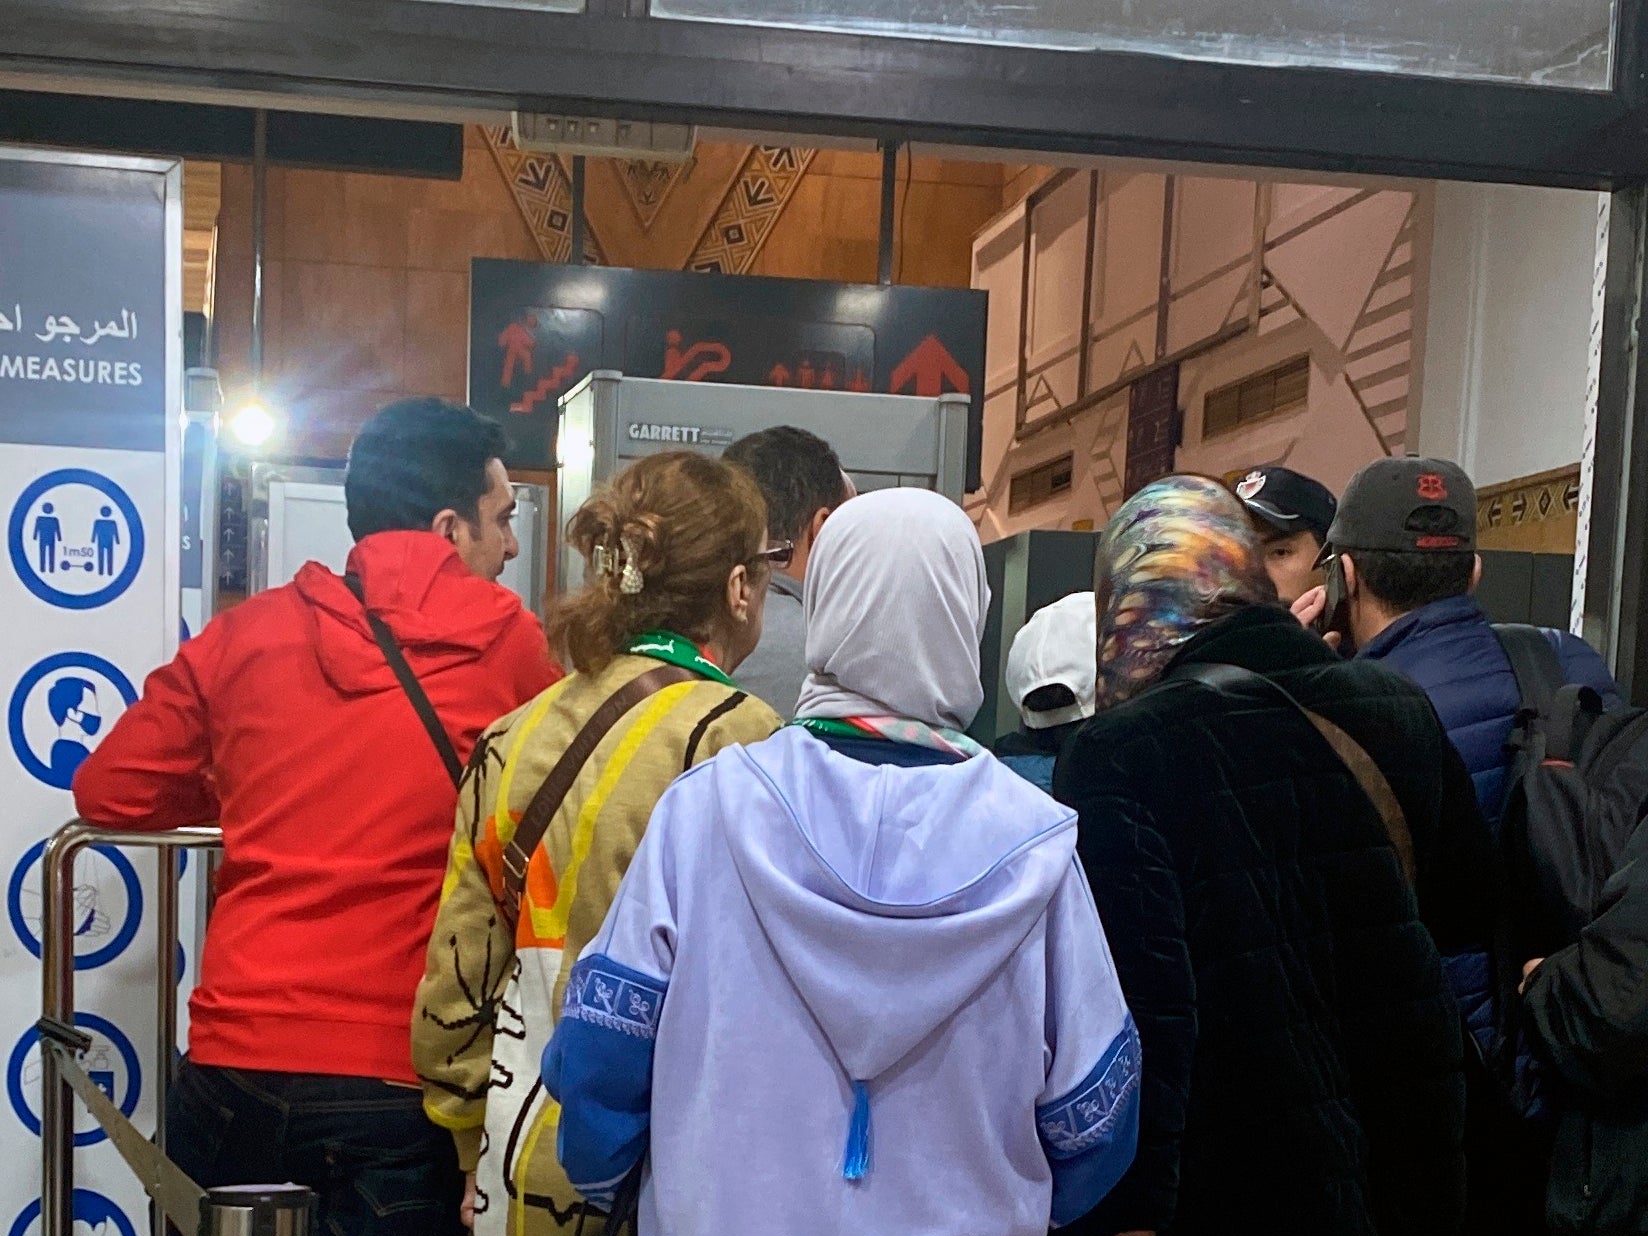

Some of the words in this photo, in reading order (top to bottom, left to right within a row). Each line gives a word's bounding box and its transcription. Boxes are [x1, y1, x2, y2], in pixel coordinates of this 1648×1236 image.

[35, 307, 138, 345] المرجو
[0, 355, 143, 386] MEASURES
[628, 423, 700, 443] GARRETT
